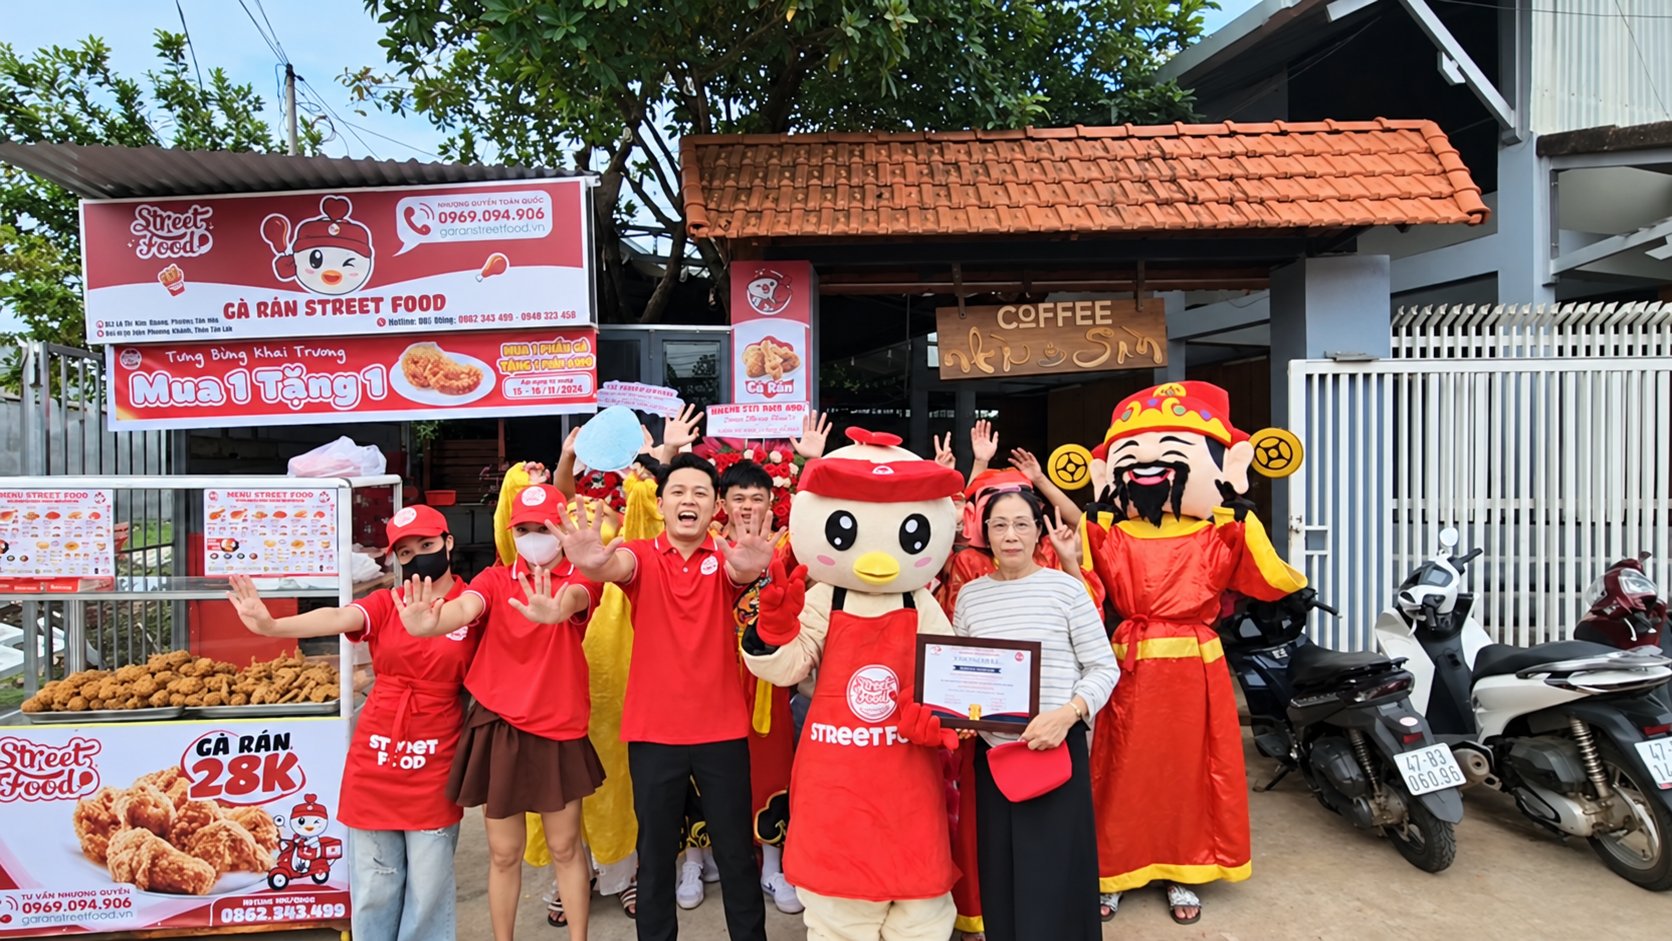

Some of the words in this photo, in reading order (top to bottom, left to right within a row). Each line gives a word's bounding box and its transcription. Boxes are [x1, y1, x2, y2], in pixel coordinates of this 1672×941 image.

[132, 205, 213, 233] Street
[438, 207, 545, 224] 0969.094.906
[137, 230, 201, 257] Food
[440, 223, 546, 239] garanstreetfood.vn
[223, 298, 250, 320] GÀ
[256, 296, 298, 318] RÁN
[304, 297, 385, 317] STREET
[391, 293, 447, 313] FOOD
[544, 312, 558, 320] 323
[130, 371, 225, 406] Mua
[227, 369, 250, 403] 1
[254, 363, 360, 410] Tặng
[361, 364, 387, 401] 1
[196, 732, 230, 757] GÀ
[238, 729, 291, 754] RÁN
[1648, 740, 1672, 761] 47-
[0, 741, 97, 772] Street
[377, 750, 426, 769] FOD
[0, 768, 77, 797] Food
[190, 751, 299, 798] 28K
[1408, 765, 1461, 791] 060.96
[21, 910, 134, 926] garanstreetfood.vn
[22, 897, 132, 914] 0969.094.906
[221, 903, 346, 923] 0862.343.499
